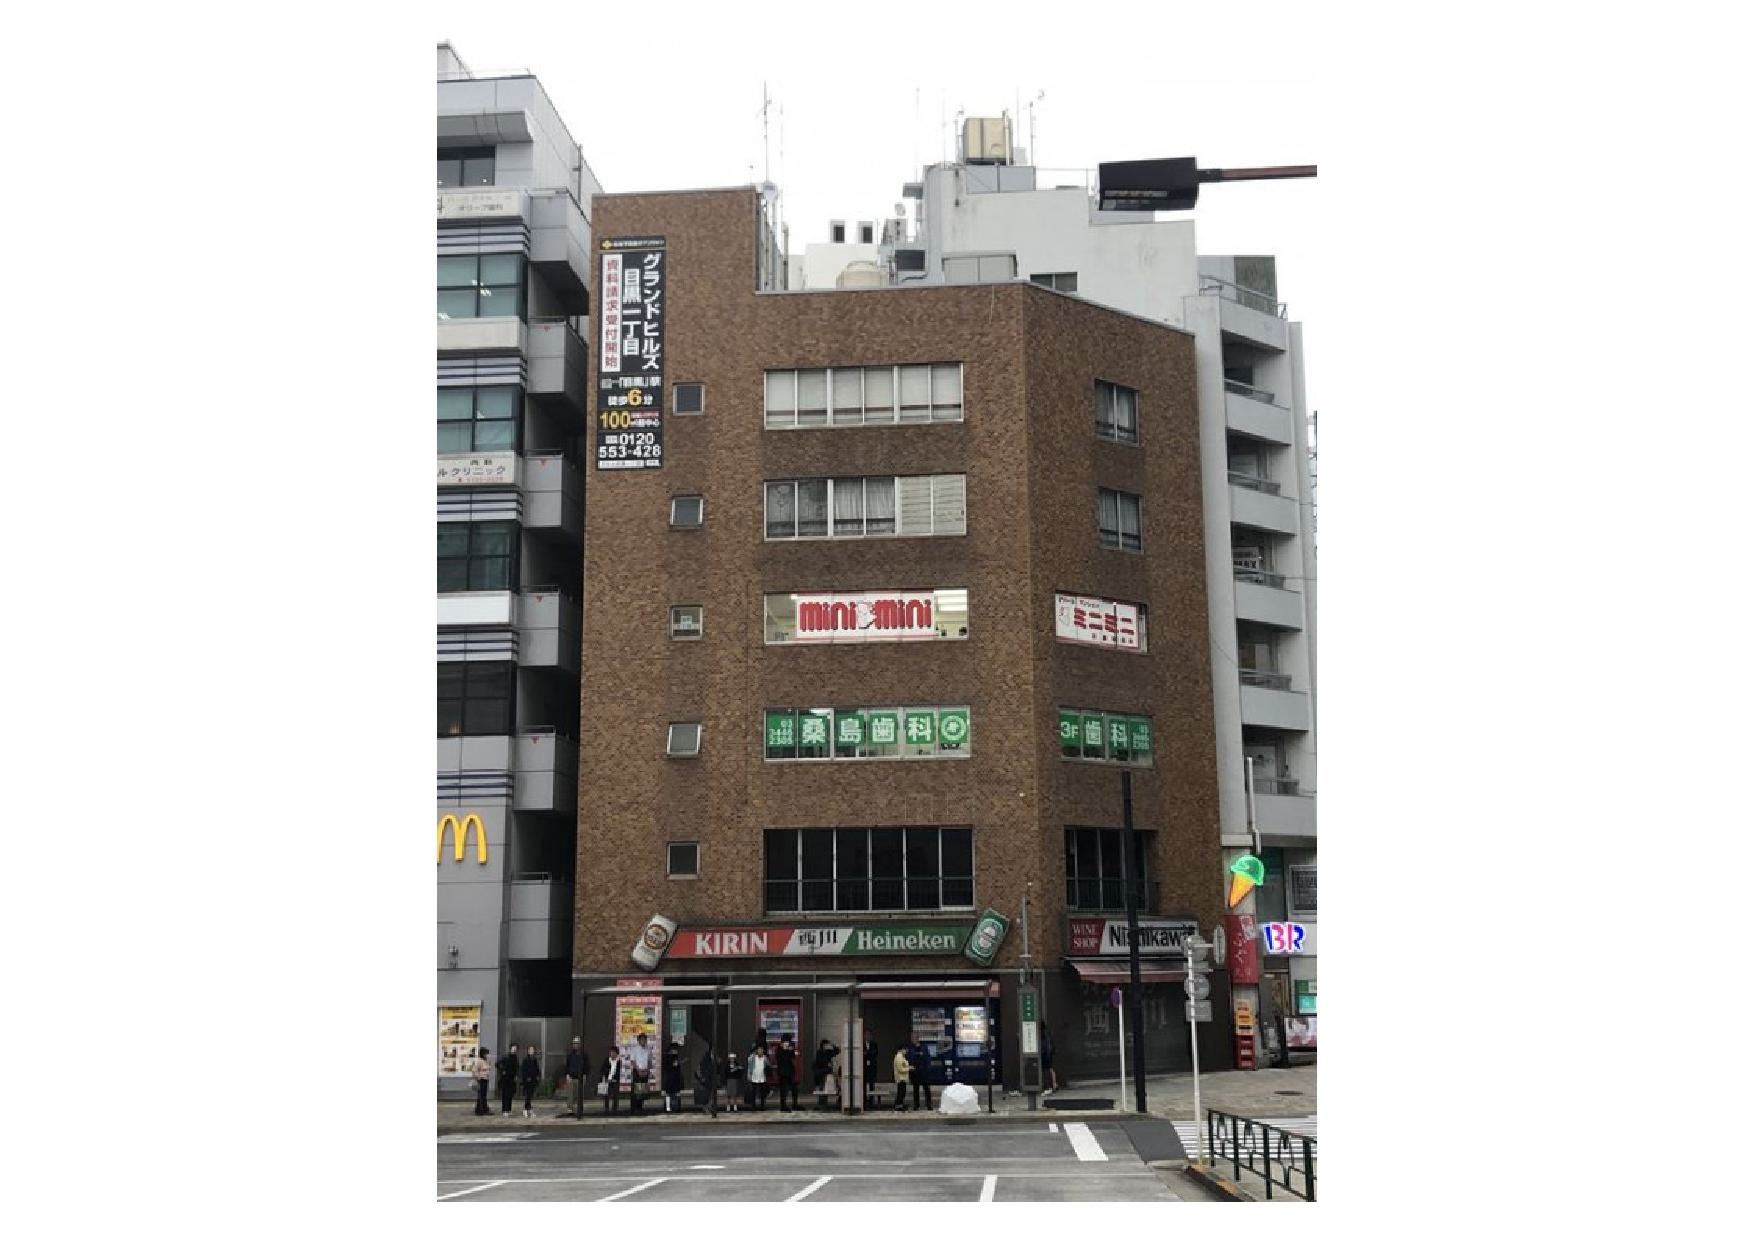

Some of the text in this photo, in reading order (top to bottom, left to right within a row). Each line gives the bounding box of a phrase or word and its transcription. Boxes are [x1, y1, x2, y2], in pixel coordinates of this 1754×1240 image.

[623, 268, 641, 356] 目黒一丁目
[643, 252, 661, 369] グランドヒルズ
[599, 445, 661, 458] 553-428
[619, 432, 654, 445] 0120
[799, 599, 931, 631] mini mini
[1073, 607, 1135, 636] ミニミニ
[802, 716, 931, 744] 桑島歯科
[1060, 721, 1079, 739] 3F
[1085, 720, 1128, 748] 歯科
[857, 929, 956, 951] Heineken
[1072, 923, 1097, 937] WINE
[1073, 936, 1098, 949] SHOP
[694, 931, 769, 956] KIRIN
